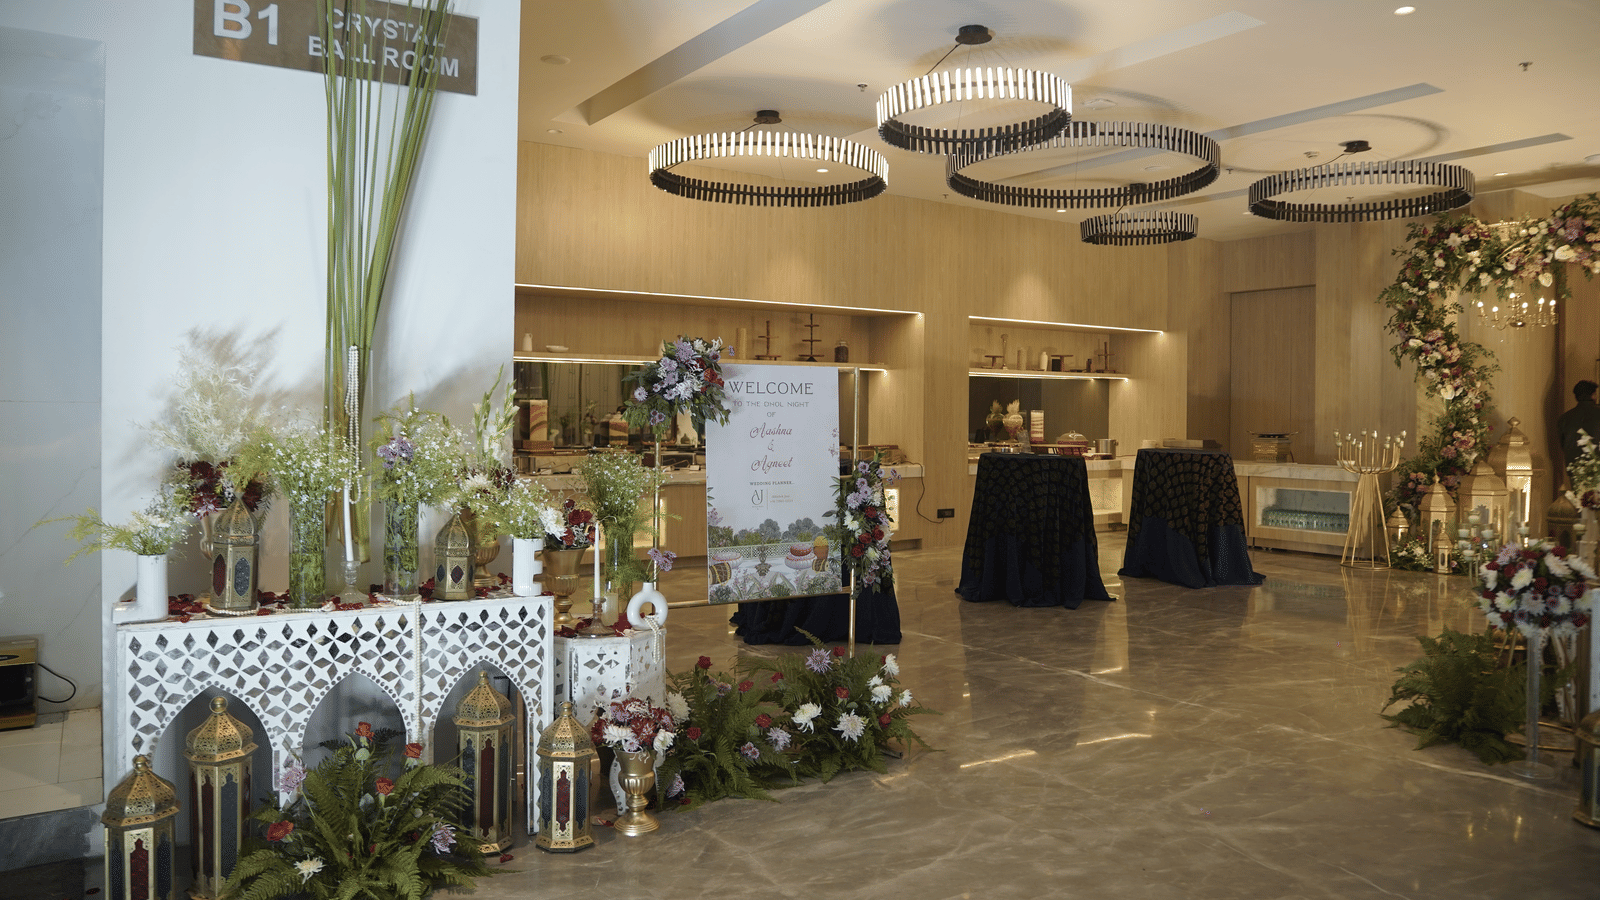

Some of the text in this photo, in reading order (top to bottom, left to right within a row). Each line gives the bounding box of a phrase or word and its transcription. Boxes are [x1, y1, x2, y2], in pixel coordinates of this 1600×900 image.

[213, 0, 278, 45] B1
[383, 46, 459, 77] ROOM
[729, 381, 813, 395] WELCOME
[750, 422, 792, 438] Aashna
[751, 455, 793, 474] Agneet
